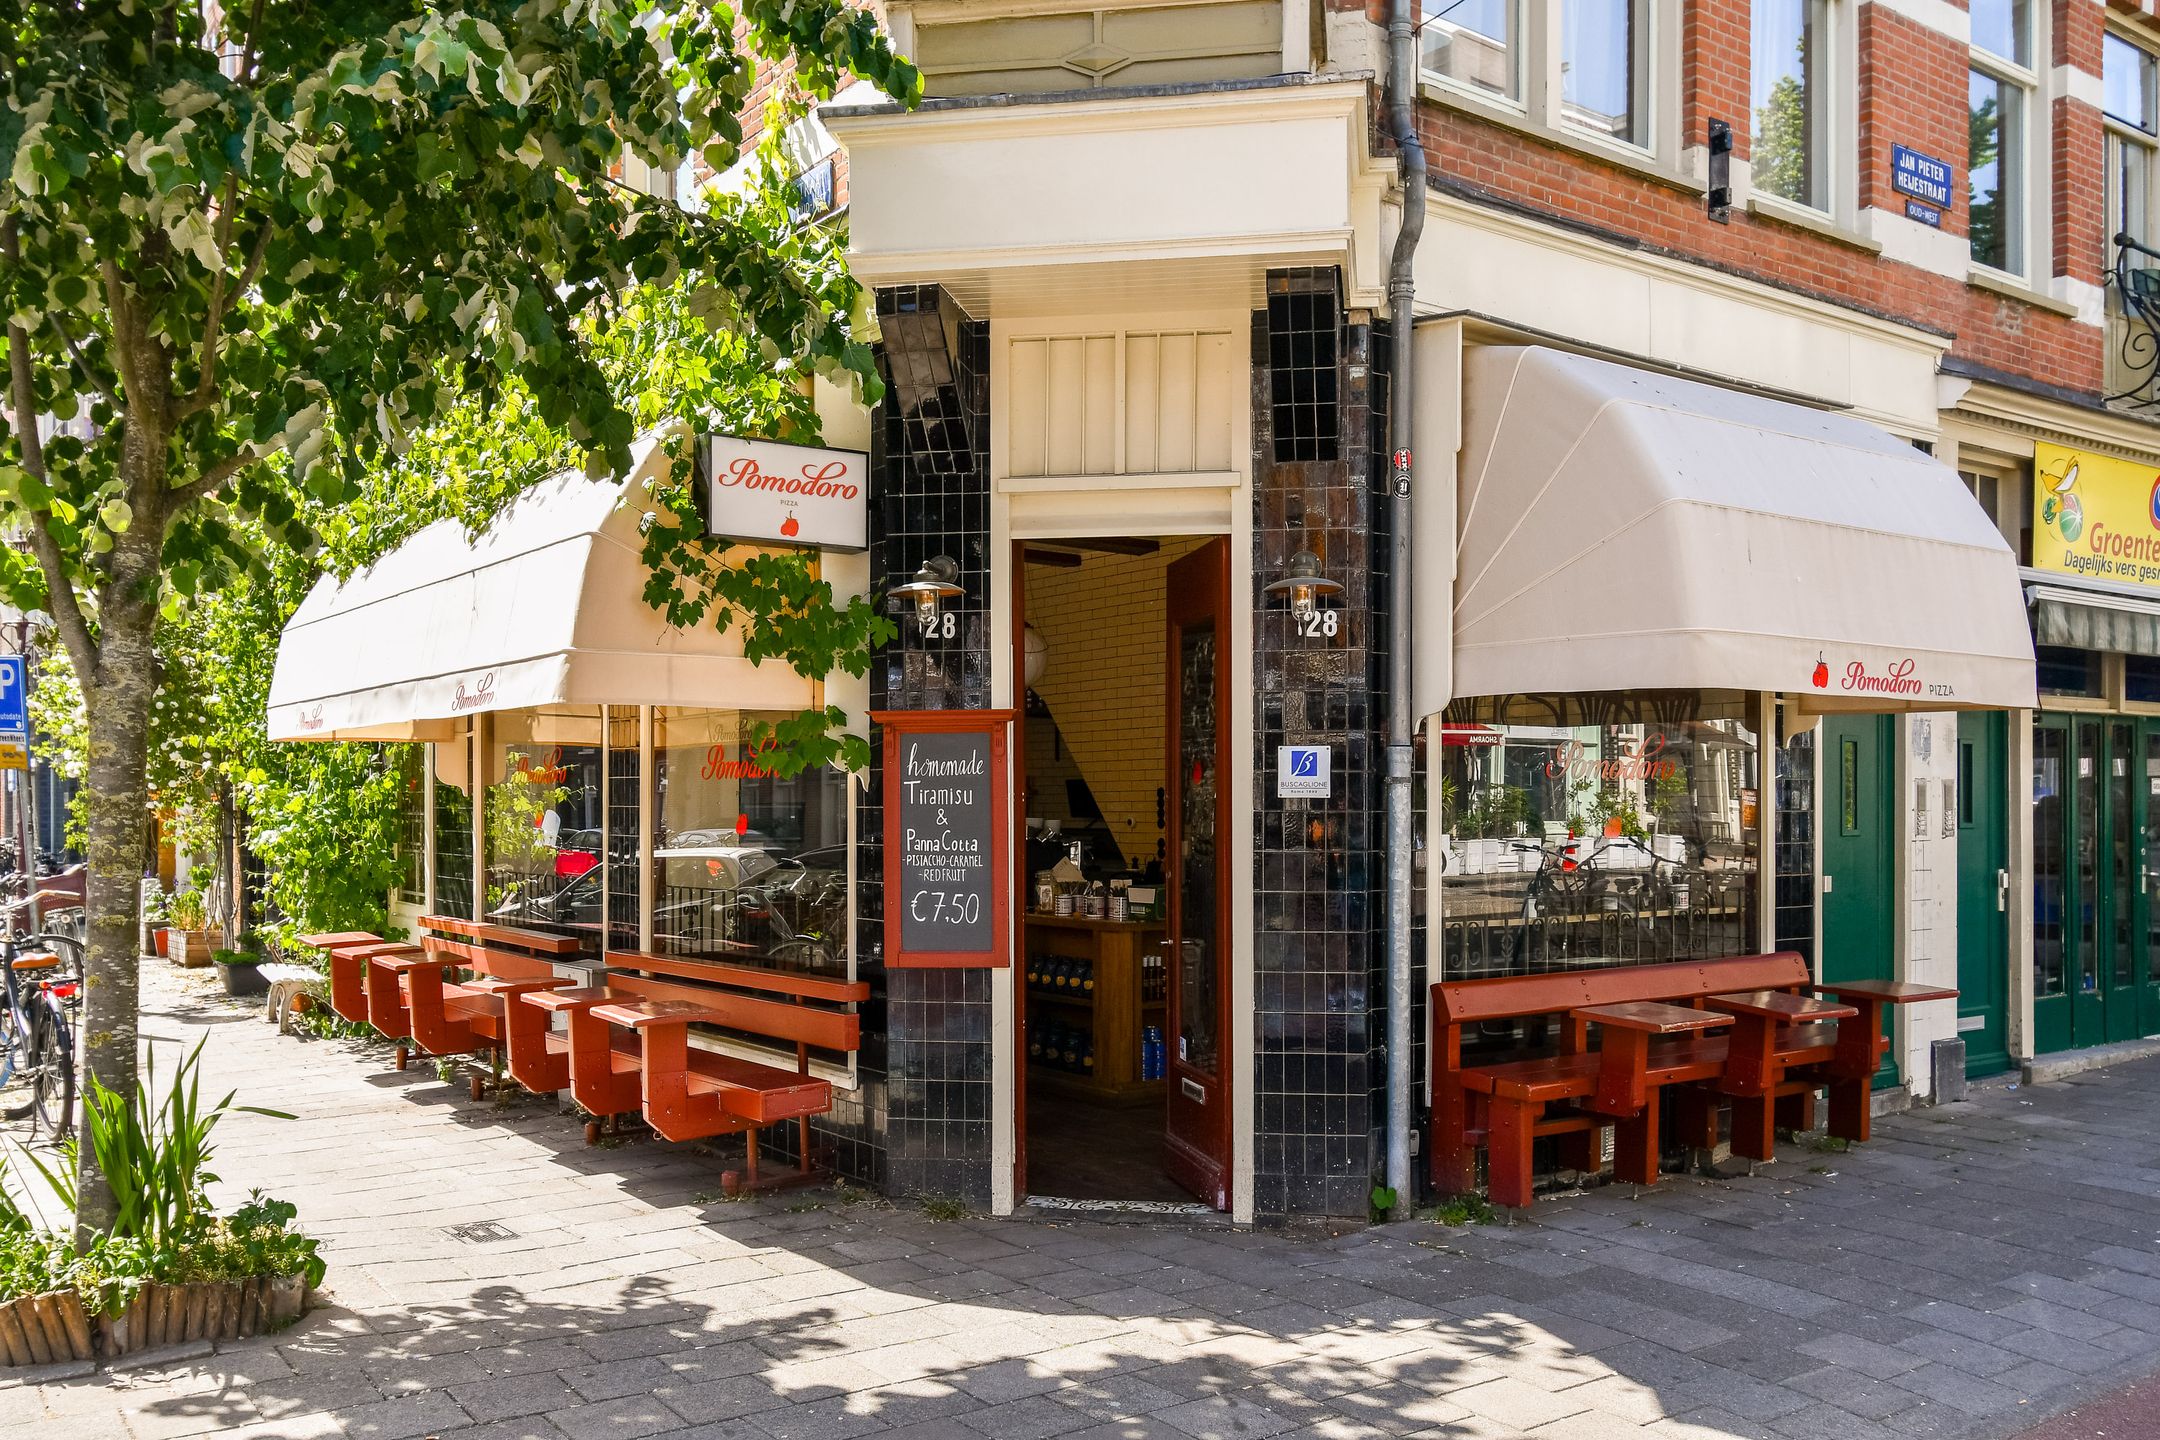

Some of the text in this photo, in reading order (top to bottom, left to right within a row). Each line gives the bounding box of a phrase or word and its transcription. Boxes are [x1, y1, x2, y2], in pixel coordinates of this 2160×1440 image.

[1900, 153, 1944, 182] JAN PIETER
[1909, 204, 1938, 223] OUD-WEST
[718, 458, 858, 500] Pomodoro
[780, 499, 799, 507] PIZZA
[2064, 549, 2112, 576] Dagelijks
[2115, 561, 2136, 577] vers
[1841, 658, 1955, 697] Pomodoro PIZZA
[452, 672, 495, 712] Pomodoro
[907, 742, 984, 776] homemade
[1545, 732, 1676, 781] Pomodoro
[904, 780, 973, 805] Tiramisu
[936, 808, 948, 825] &
[906, 828, 978, 852] Panna Cotta
